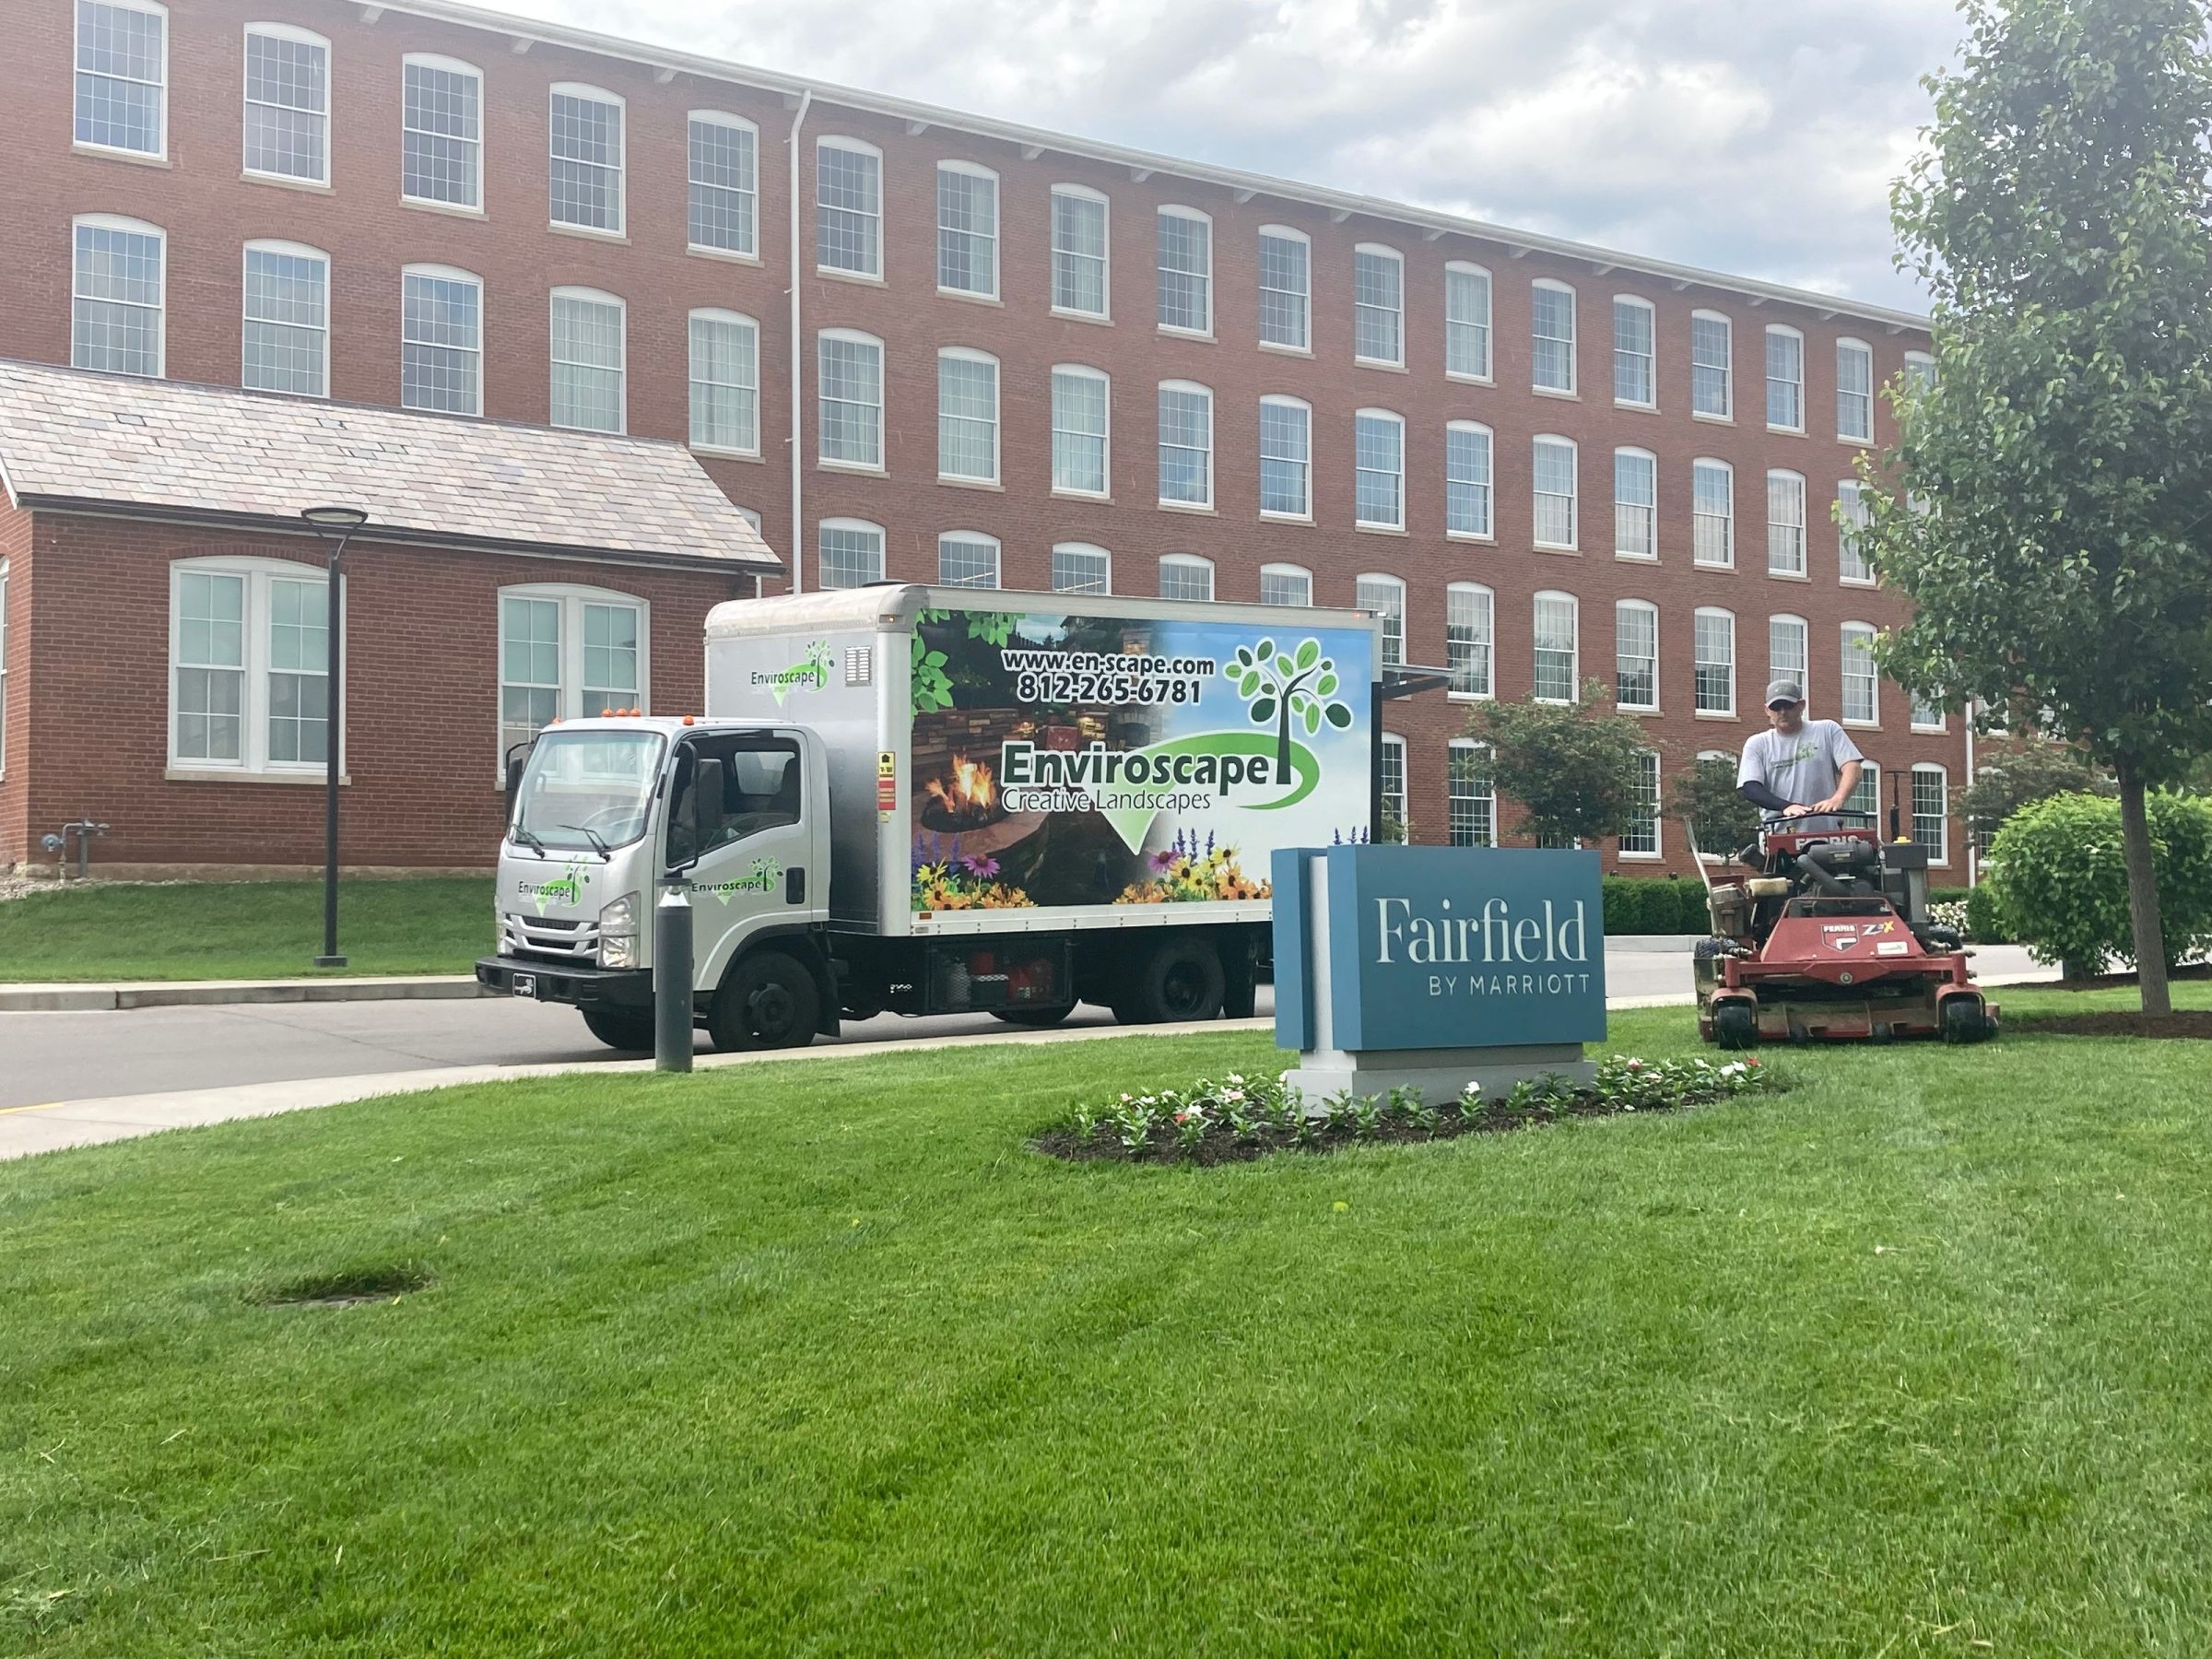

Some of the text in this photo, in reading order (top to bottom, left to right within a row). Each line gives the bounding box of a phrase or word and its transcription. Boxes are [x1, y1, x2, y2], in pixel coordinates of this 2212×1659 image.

[1003, 651, 1215, 677] www.en-scape.com
[751, 671, 815, 687] Enviroscape
[1018, 674, 1201, 703] 812-265-6781
[1005, 744, 1269, 796] Enviroscape
[1002, 788, 1211, 814] Creative Landscapes
[518, 880, 571, 900] Enviroscape
[691, 880, 761, 892] Enviroscape
[1373, 898, 1589, 963] Fairfield
[1429, 973, 1590, 996] BY MARRIOTT
